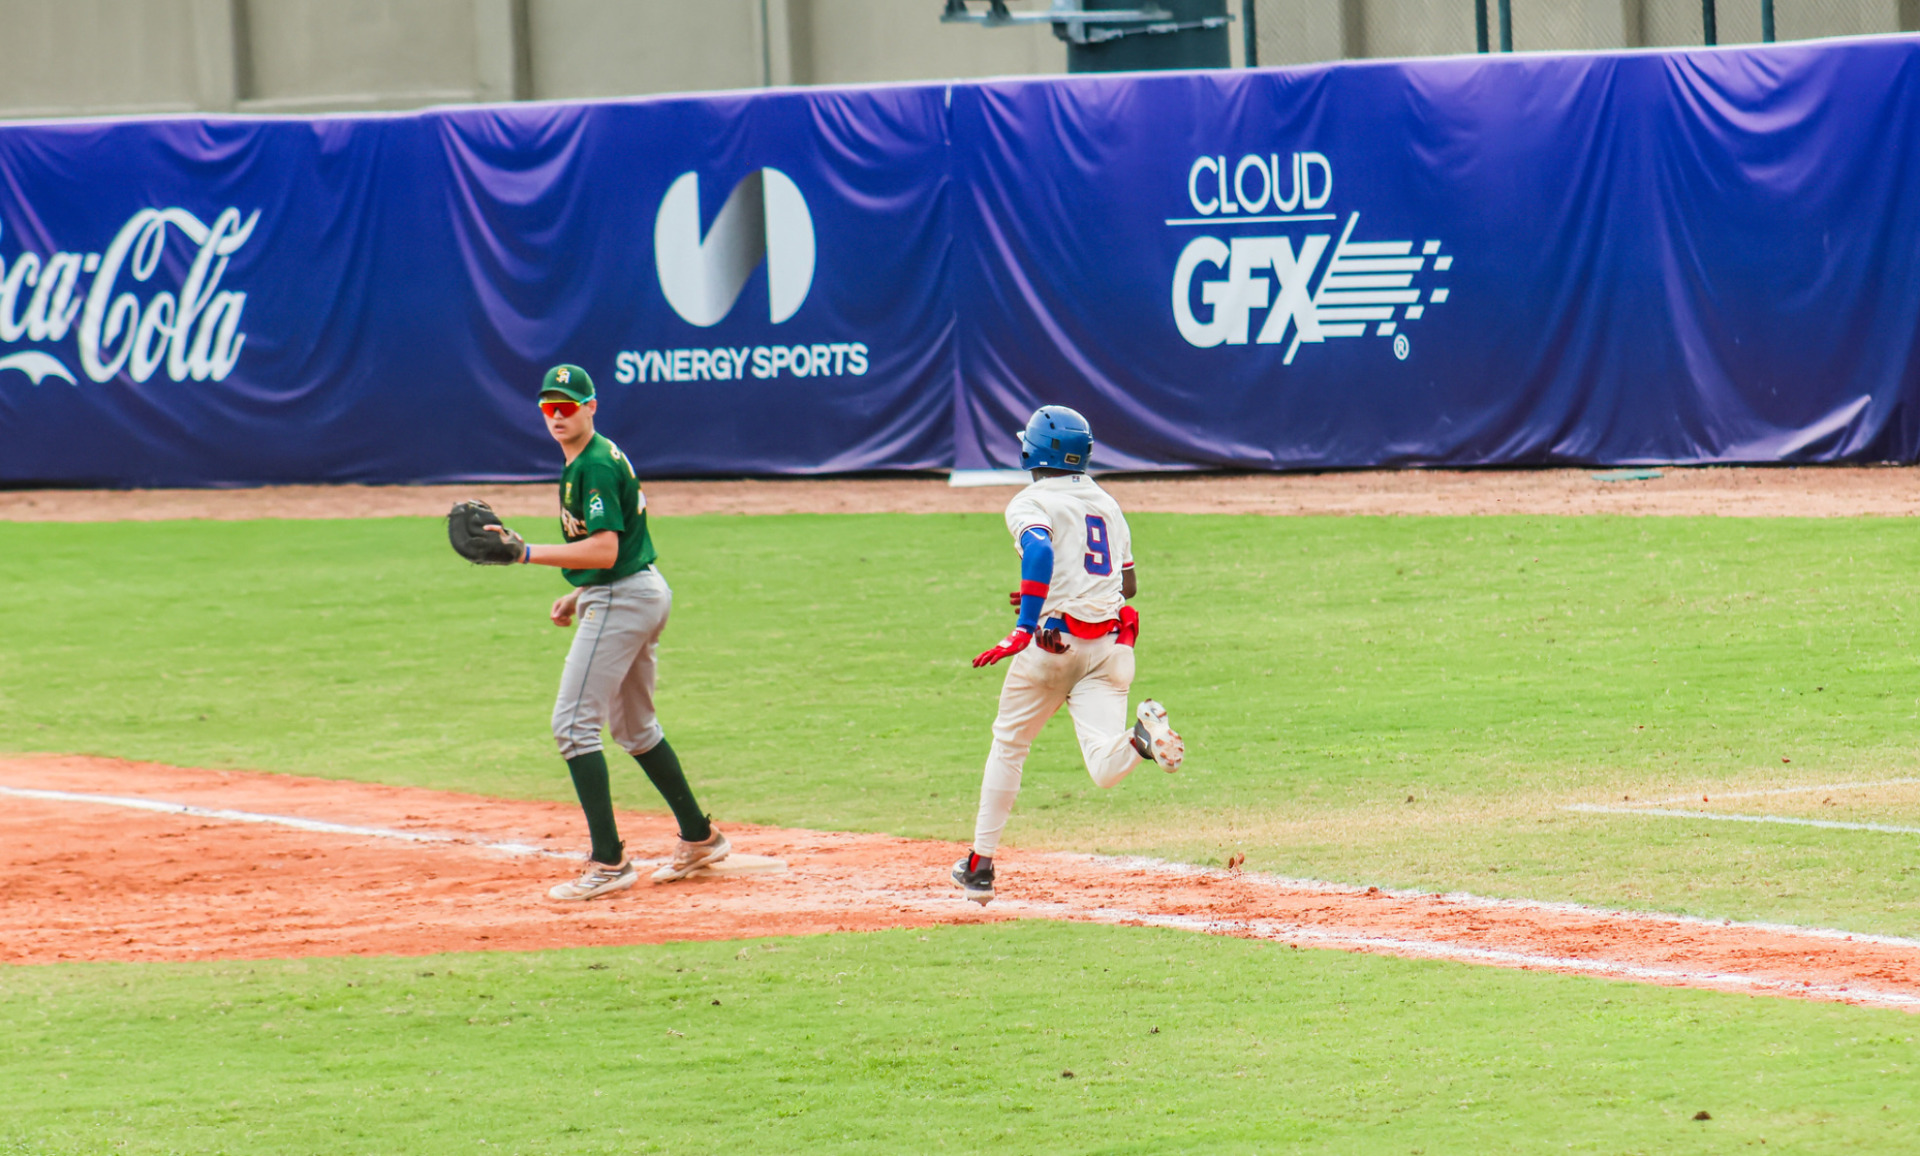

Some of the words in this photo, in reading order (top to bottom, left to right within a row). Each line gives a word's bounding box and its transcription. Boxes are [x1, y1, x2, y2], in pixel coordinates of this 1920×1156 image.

[1188, 152, 1333, 215] CLOUD
[0, 206, 262, 383] ca-Cola
[1172, 234, 1331, 348] GFX
[615, 347, 750, 384] SYNERGY
[751, 341, 869, 379] SPORTS
[1084, 513, 1113, 577] 9
